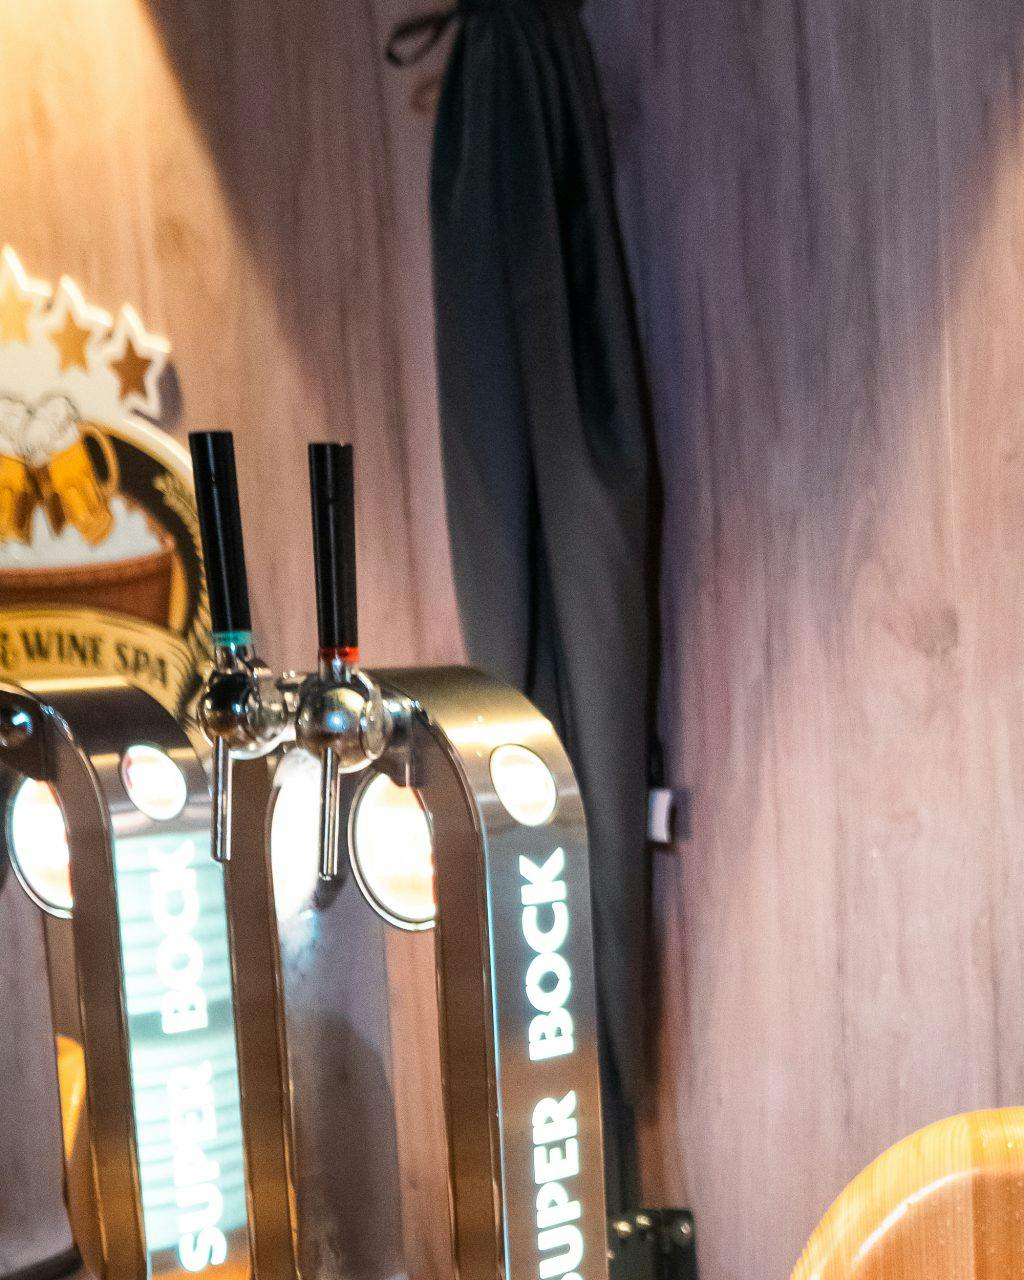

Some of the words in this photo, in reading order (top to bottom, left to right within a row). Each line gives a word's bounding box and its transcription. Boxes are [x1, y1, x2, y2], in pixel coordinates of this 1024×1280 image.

[19, 628, 103, 668] WINE
[114, 642, 168, 689] SPA
[518, 846, 570, 1061] BOCK
